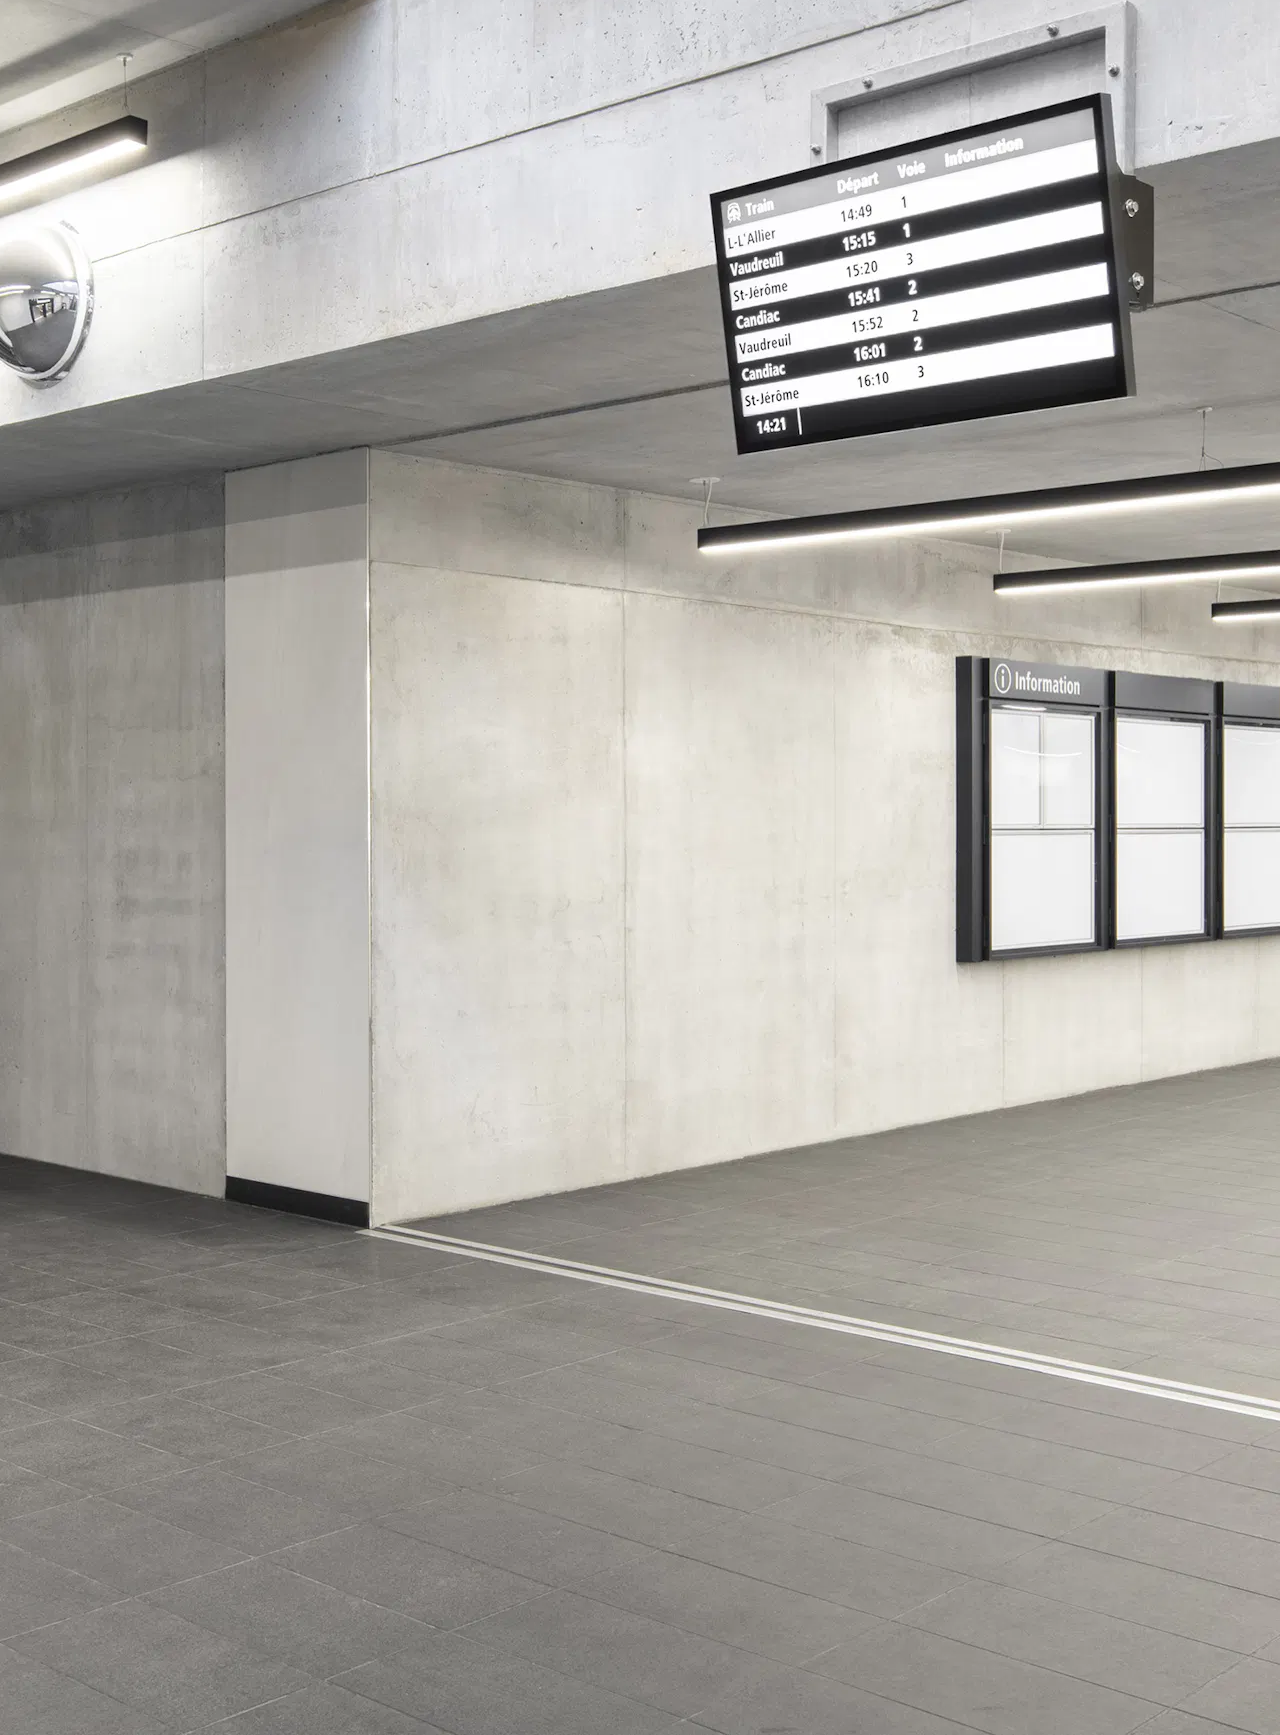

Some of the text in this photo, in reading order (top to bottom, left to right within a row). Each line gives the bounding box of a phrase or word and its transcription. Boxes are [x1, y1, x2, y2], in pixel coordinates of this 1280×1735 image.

[745, 136, 1024, 216] Train Départ Voie Information
[728, 196, 907, 249] L-L'Allier 14:49 1
[729, 223, 911, 276] Vaudreuil 15:15 1
[733, 252, 913, 302] St-Jérôme 15:20 3
[735, 279, 918, 329] Candiac 15:41 2
[739, 309, 919, 354] Vaudreuil 15:52 2
[741, 336, 923, 381] Candiac 16:01 2
[745, 365, 925, 407] St-Jérôme 16:10 3
[756, 417, 787, 434] 14:21
[1015, 671, 1081, 695] Information
